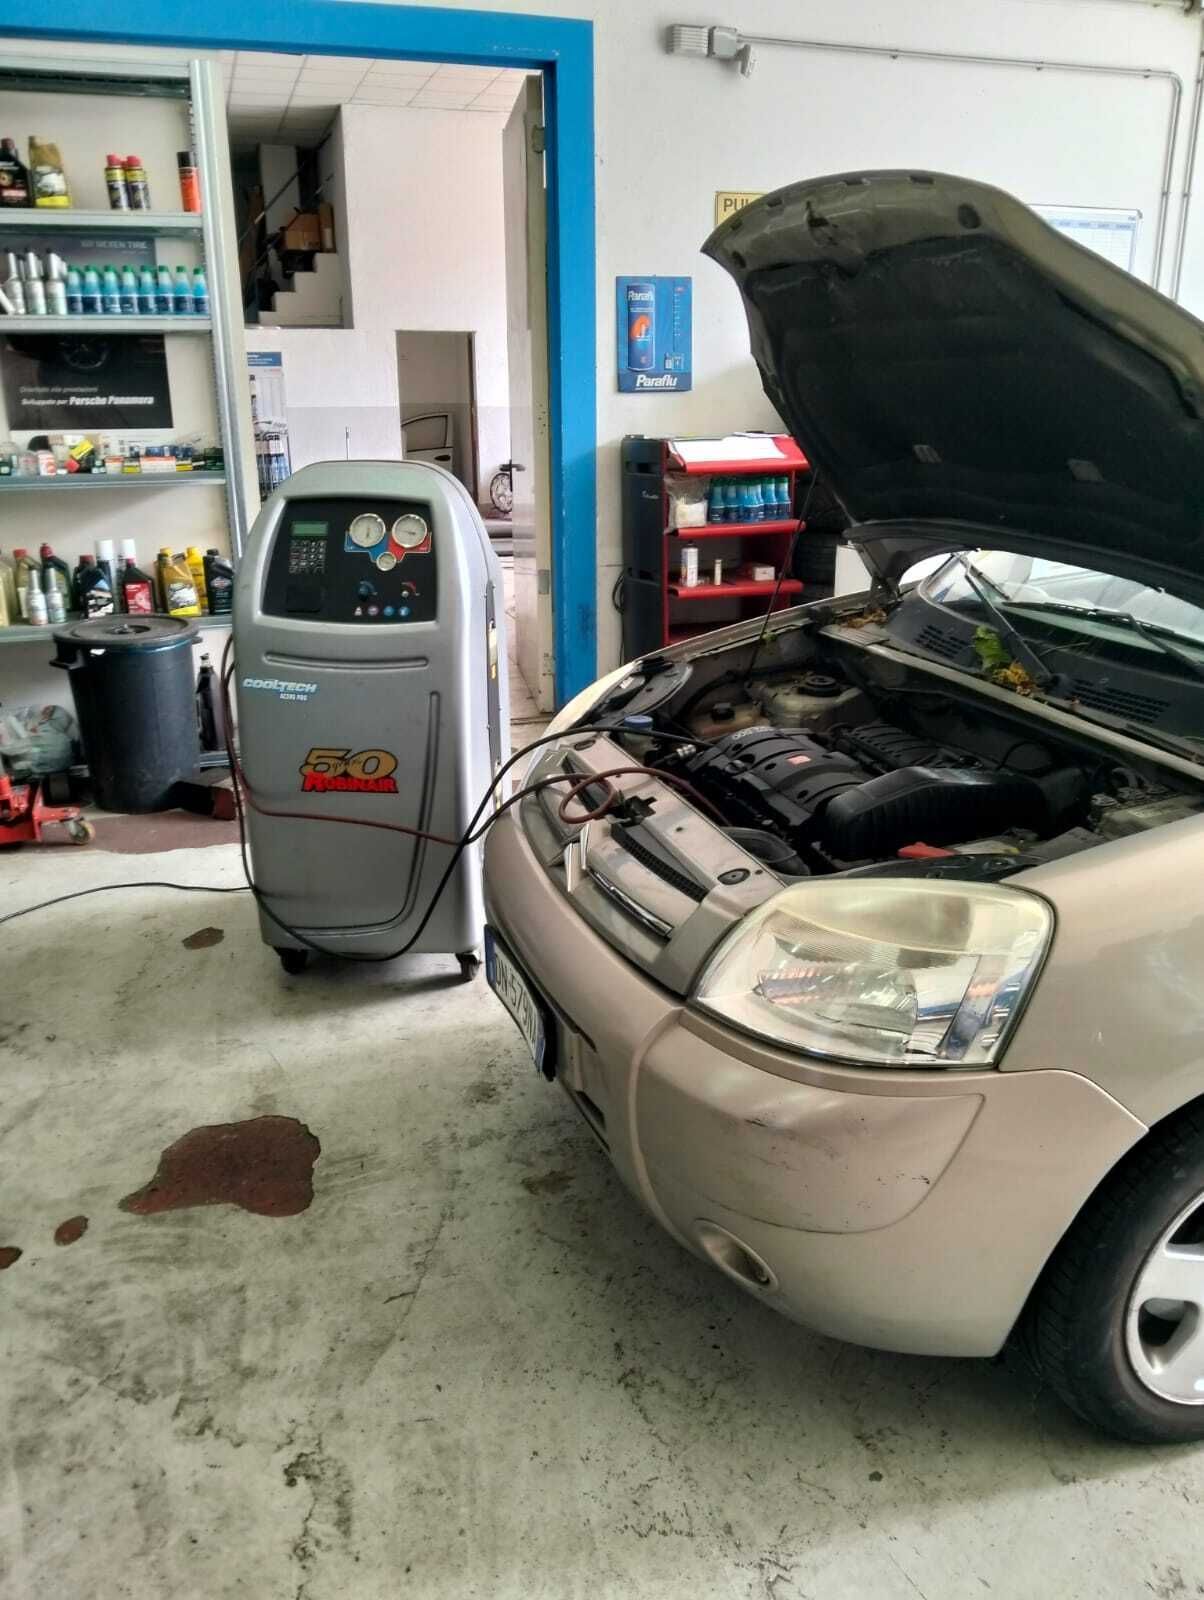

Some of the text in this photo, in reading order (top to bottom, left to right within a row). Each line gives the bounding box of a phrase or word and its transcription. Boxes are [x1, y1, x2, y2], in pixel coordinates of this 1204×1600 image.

[636, 374, 677, 387] Paraflu
[69, 396, 107, 405] Porsche
[108, 395, 154, 405] Panamera
